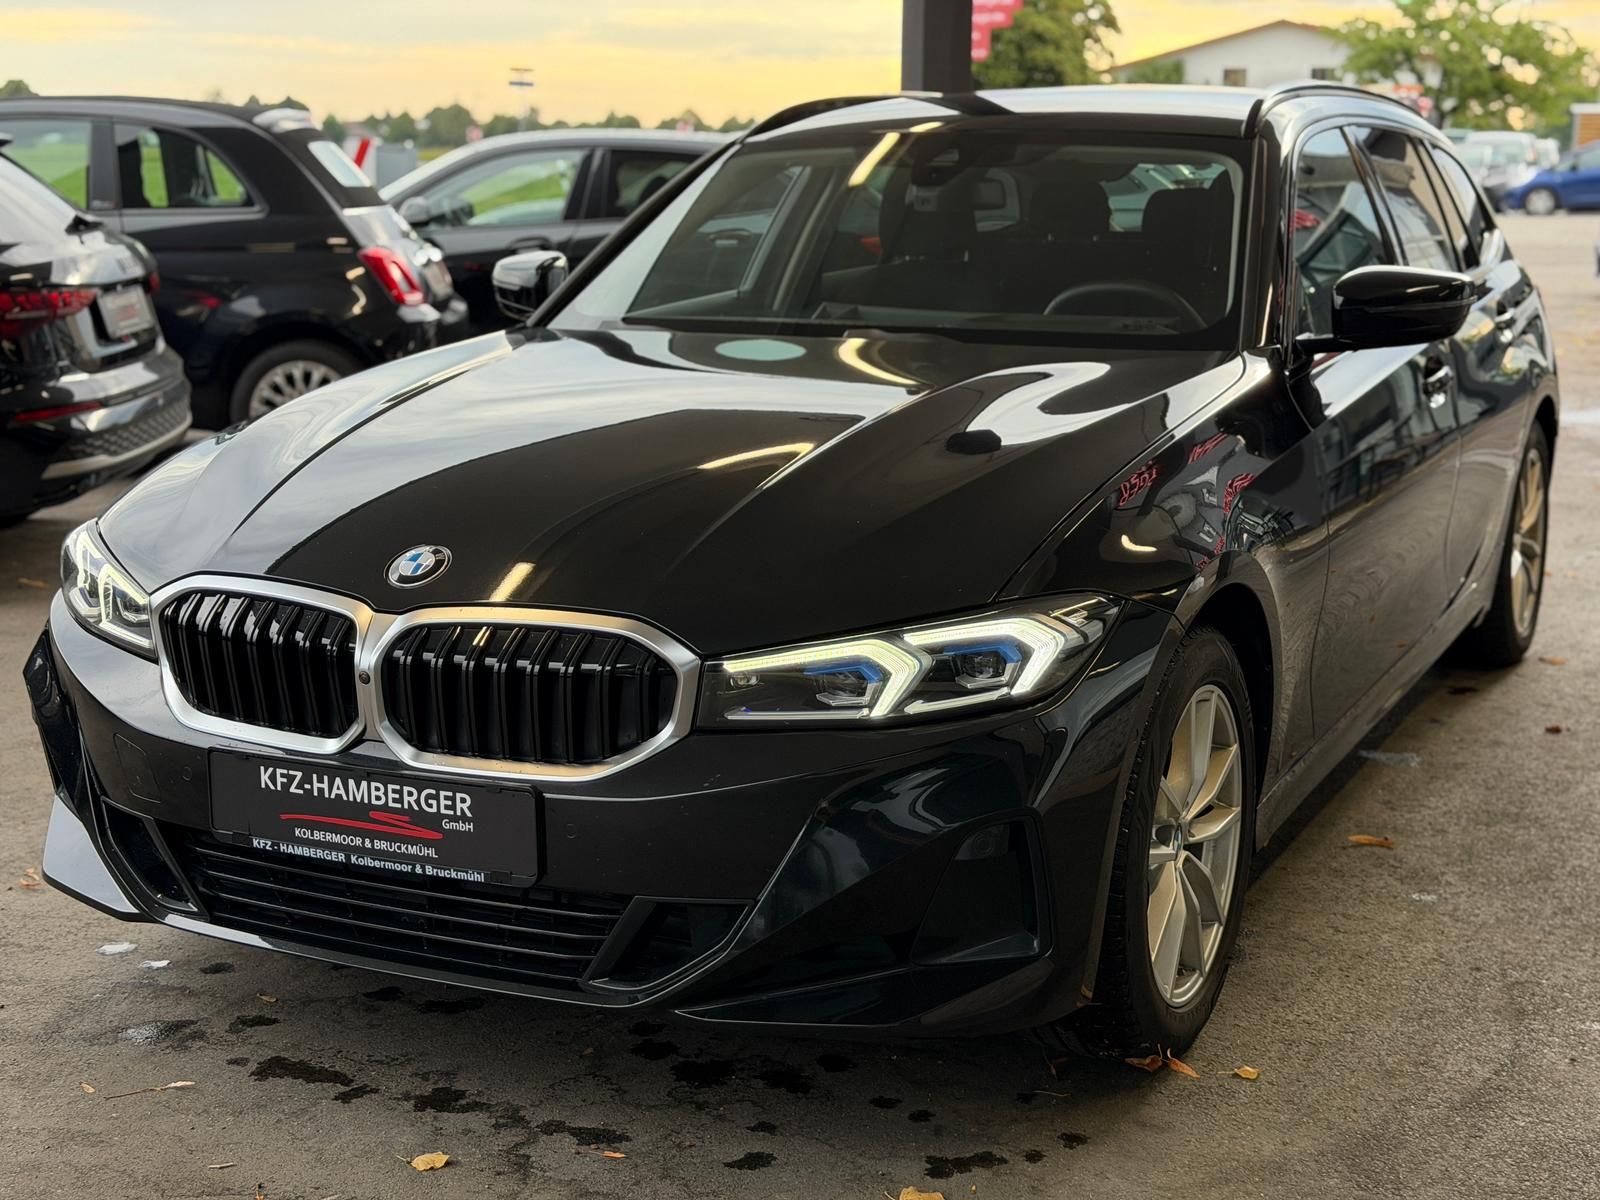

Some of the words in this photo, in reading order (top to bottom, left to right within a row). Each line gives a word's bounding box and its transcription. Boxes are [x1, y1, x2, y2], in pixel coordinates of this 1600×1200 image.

[260, 765, 473, 818] KFZ-HAMBERGER
[294, 827, 363, 847] KOLBERMOOR
[364, 838, 372, 849] &
[374, 840, 439, 858] BRUCKMÜHL
[442, 819, 474, 832] GmbH
[252, 838, 273, 850] KFZ
[279, 843, 346, 863] HAMBERGER
[350, 854, 413, 873] Kolbermoor
[415, 864, 423, 874] &
[425, 865, 485, 883] Bruckmühl
